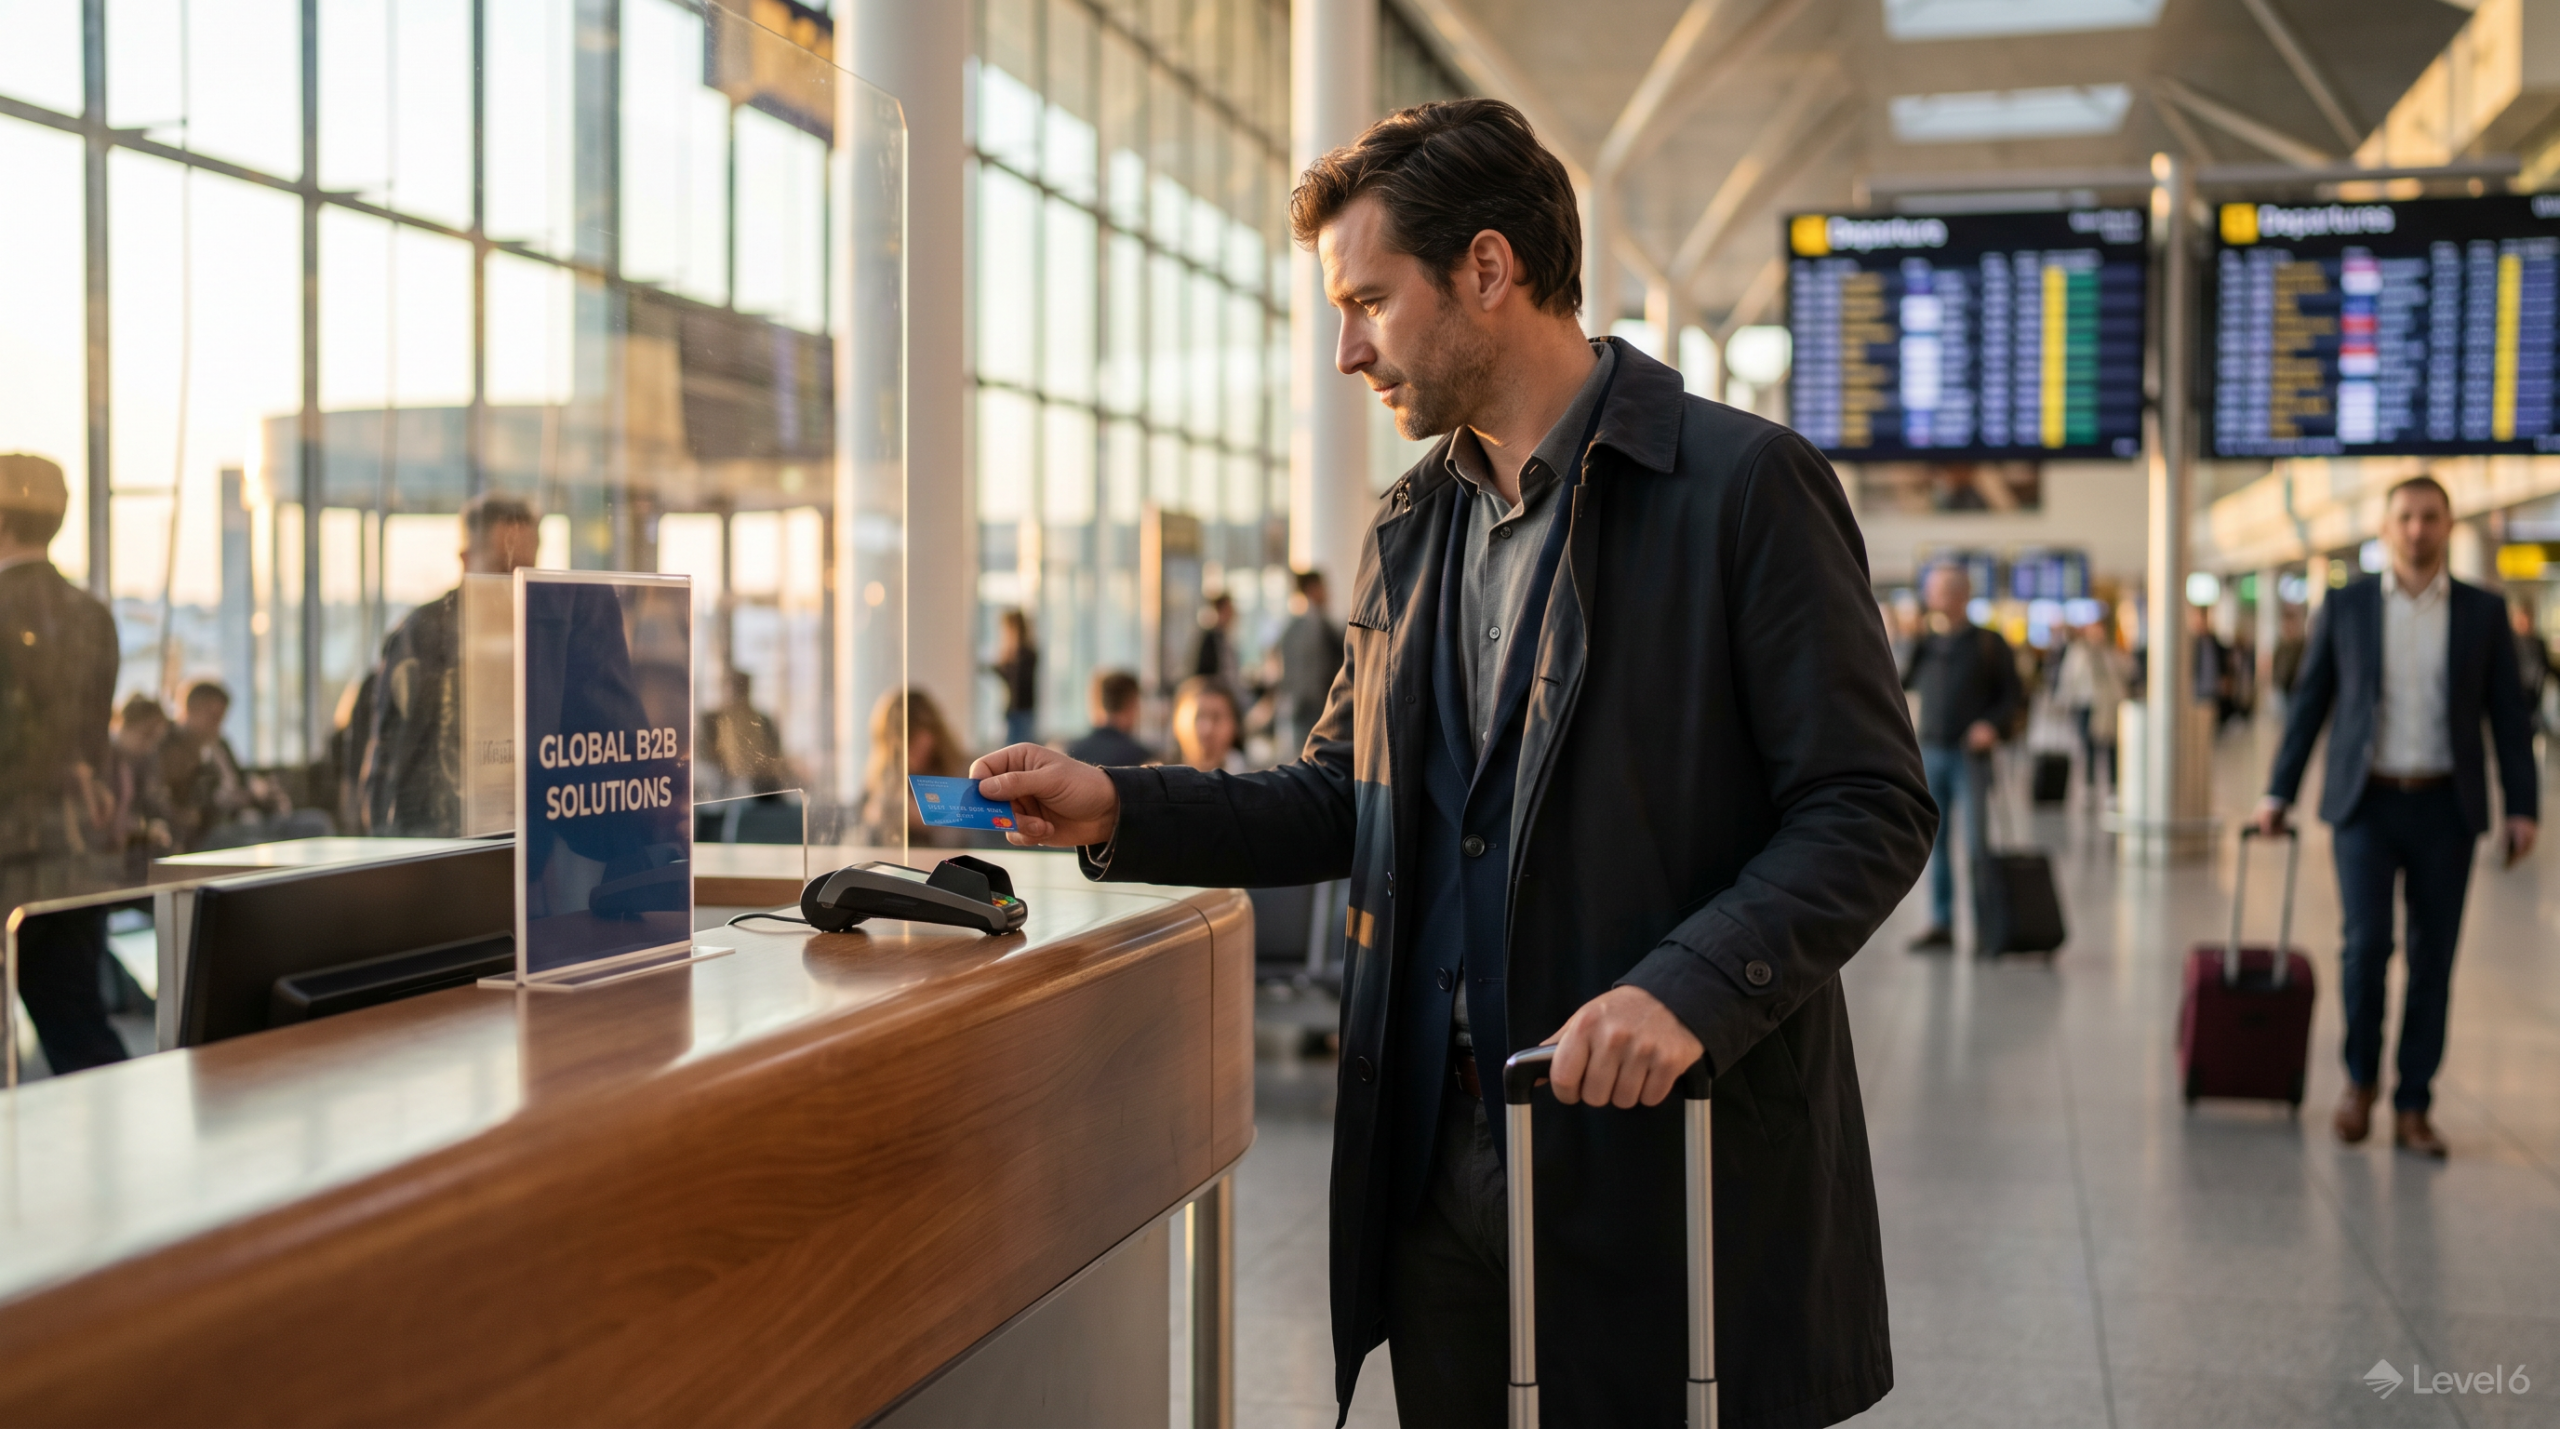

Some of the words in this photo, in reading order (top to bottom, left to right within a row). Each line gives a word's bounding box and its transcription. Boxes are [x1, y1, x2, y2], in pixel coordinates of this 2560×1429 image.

[539, 730, 631, 770] GLOBAL
[637, 727, 678, 761] B2B
[546, 776, 672, 820] SOLUTIONS
